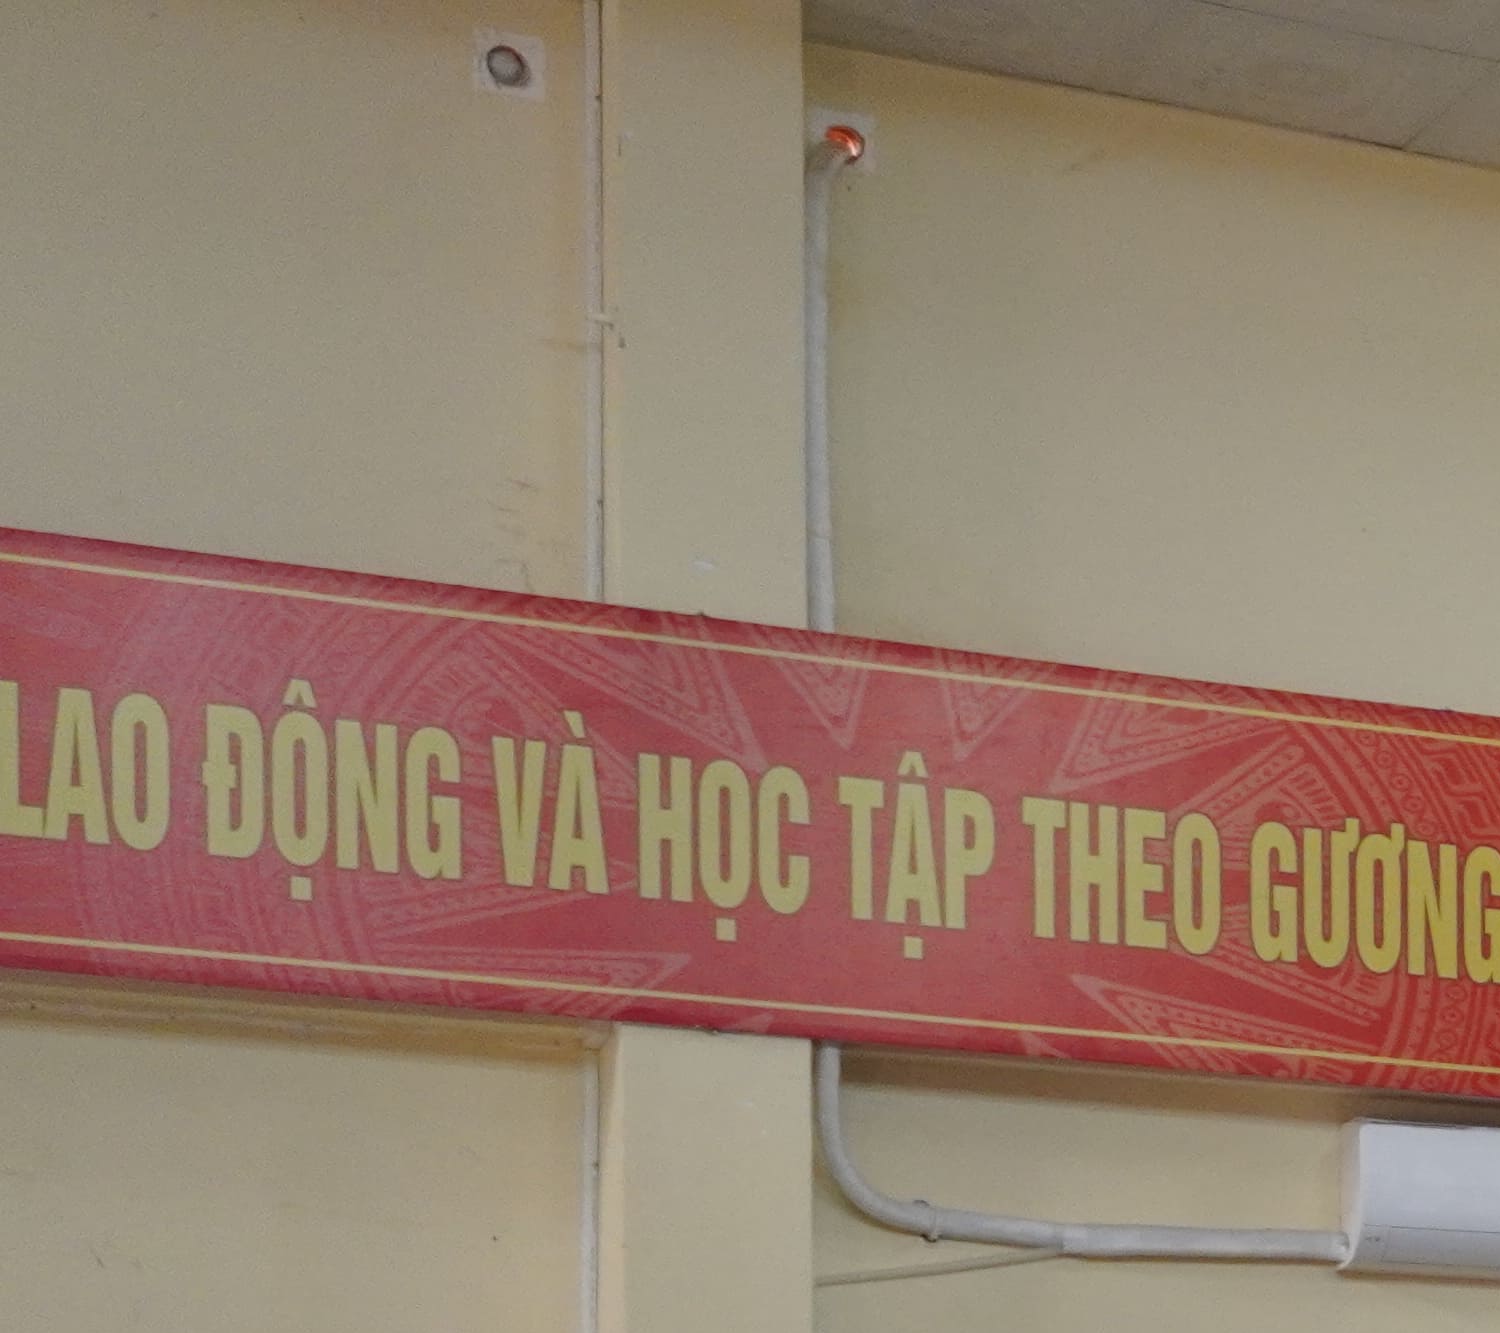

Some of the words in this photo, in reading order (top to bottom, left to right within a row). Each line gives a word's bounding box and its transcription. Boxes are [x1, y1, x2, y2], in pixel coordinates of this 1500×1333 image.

[0, 681, 170, 850] LAO
[202, 679, 462, 901] ĐỘNG
[493, 711, 609, 893] VÀ
[638, 754, 810, 941] HỌC
[837, 751, 995, 958] TẬP
[1020, 796, 1221, 955] THEO
